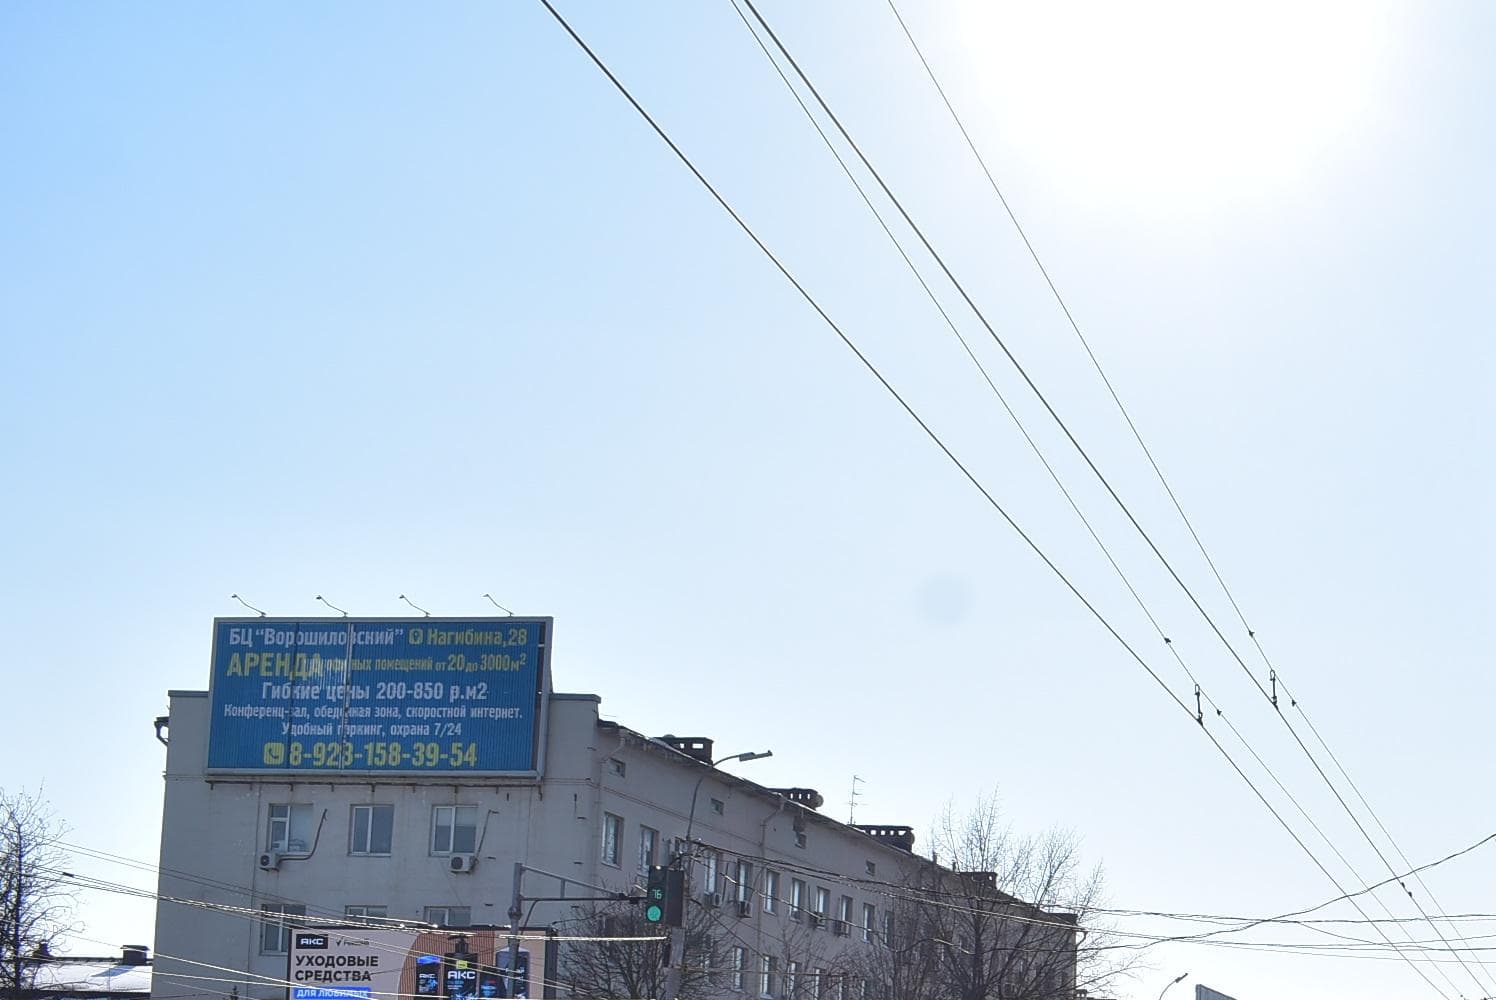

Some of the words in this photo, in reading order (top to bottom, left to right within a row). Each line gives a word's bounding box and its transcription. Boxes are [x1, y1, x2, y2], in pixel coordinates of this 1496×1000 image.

[229, 628, 253, 648] БЦ
[226, 652, 323, 681] АРЕНДА
[375, 655, 433, 673] помещений
[448, 653, 465, 672] 20
[262, 681, 320, 700] Гибкие
[326, 683, 370, 702] цены
[375, 681, 444, 700] 200-850
[374, 706, 402, 719] зона,
[406, 704, 466, 720] скоростной
[281, 722, 333, 737] Удобный
[390, 723, 430, 738] охрана
[434, 722, 462, 738] 7/24
[295, 955, 379, 968] УХОДОВЫЕ
[295, 970, 372, 983] СРЕДСТВА
[296, 989, 317, 999] ДЛЯ
